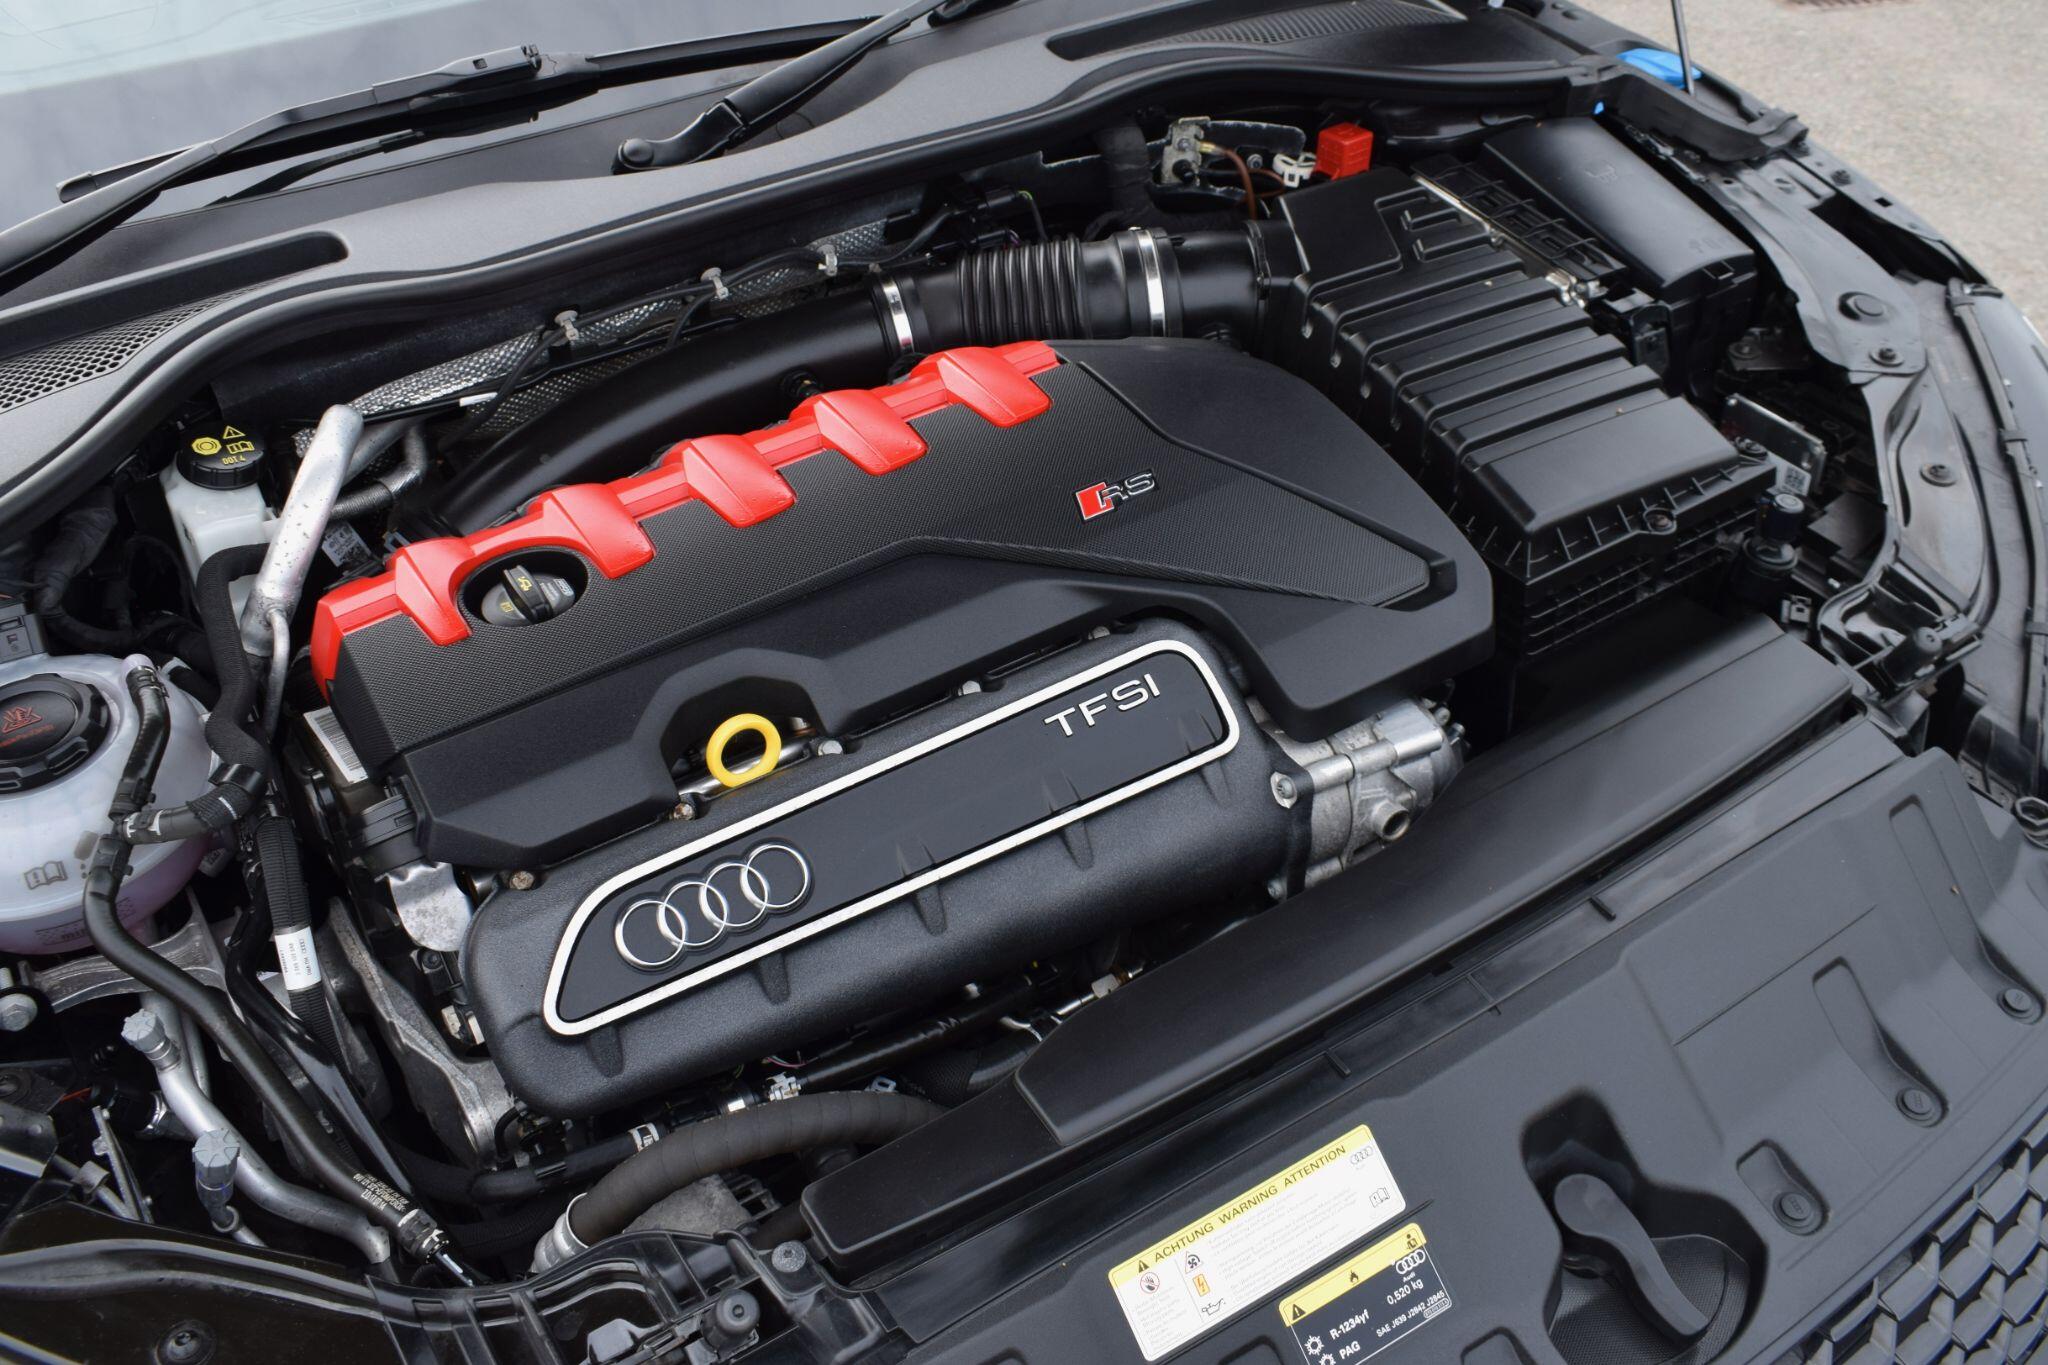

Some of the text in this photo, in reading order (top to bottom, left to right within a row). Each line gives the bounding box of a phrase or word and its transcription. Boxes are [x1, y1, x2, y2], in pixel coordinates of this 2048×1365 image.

[222, 456, 239, 465] DOT
[1086, 473, 1155, 514] RS
[1044, 673, 1160, 736] TFSI
[1154, 1145, 1346, 1262] ACHTUNG WARNING ATTENTION
[1403, 1271, 1416, 1282] Audi
[1386, 1279, 1424, 1305] 0,520 kg
[1330, 1309, 1370, 1340] R-1234yf
[1376, 1323, 1391, 1337] SAE
[1392, 1314, 1407, 1328] J639
[1339, 1340, 1361, 1360] PAG
